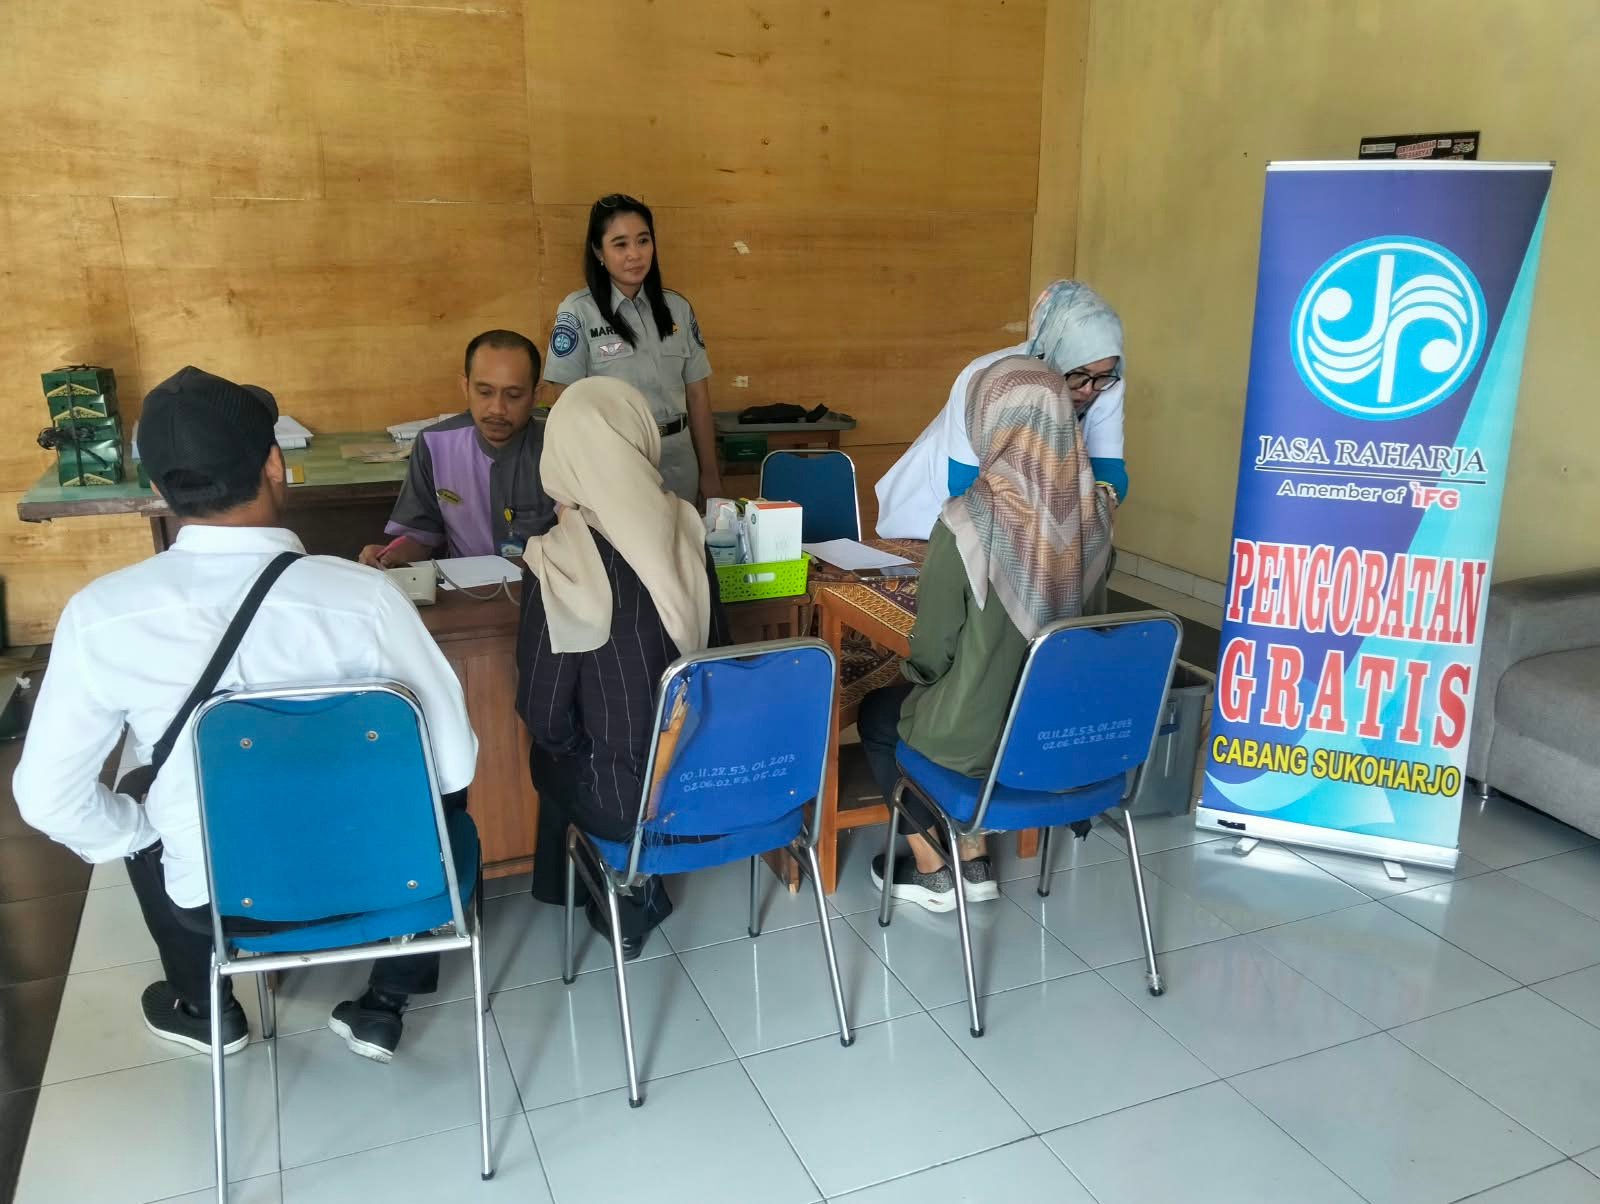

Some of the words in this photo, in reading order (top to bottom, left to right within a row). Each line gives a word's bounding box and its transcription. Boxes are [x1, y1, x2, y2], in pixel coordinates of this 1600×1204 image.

[1257, 435, 1328, 464] JASA
[1335, 440, 1488, 475] RAHARJA
[1297, 481, 1381, 503] member
[1380, 487, 1406, 504] of
[1227, 538, 1489, 646] PENGOBATAN
[1219, 637, 1472, 749] GRATIS
[1212, 735, 1307, 775] CABANG
[1312, 749, 1460, 797] SUKOHARJO
